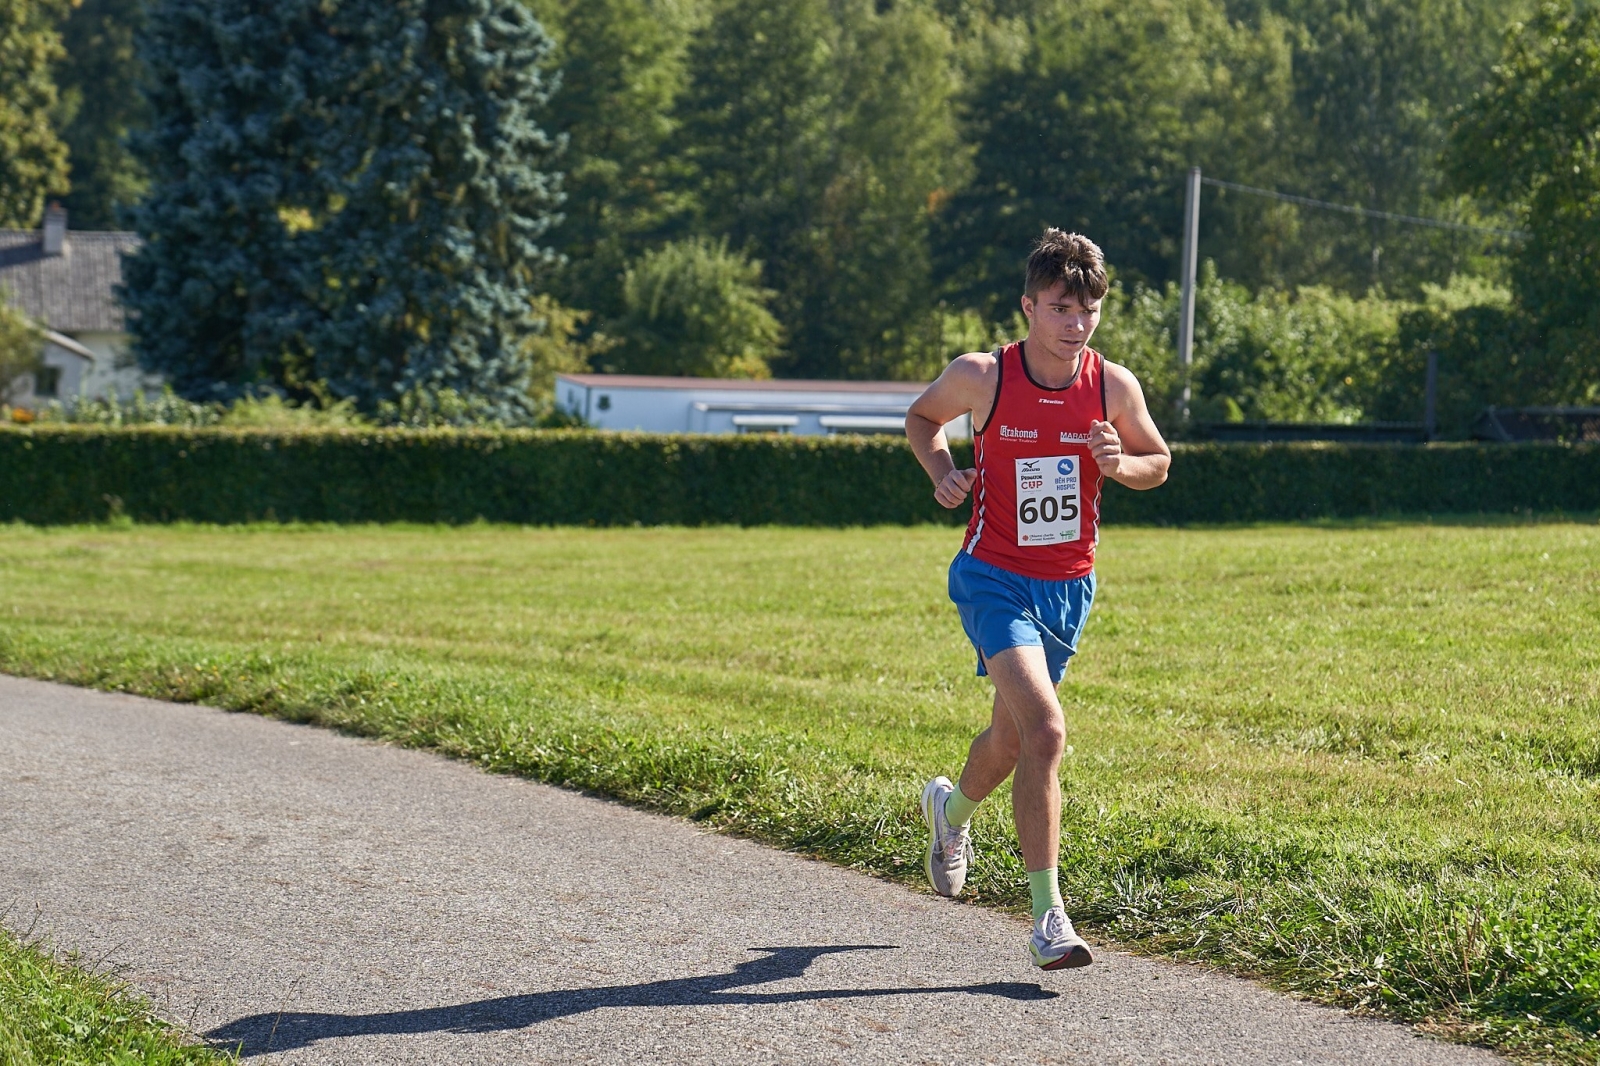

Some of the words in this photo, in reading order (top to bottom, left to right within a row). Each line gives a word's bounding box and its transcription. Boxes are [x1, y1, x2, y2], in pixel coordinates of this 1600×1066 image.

[1000, 425, 1038, 439] Krakonoš
[1021, 481, 1043, 489] CUP
[1020, 495, 1078, 524] 605
